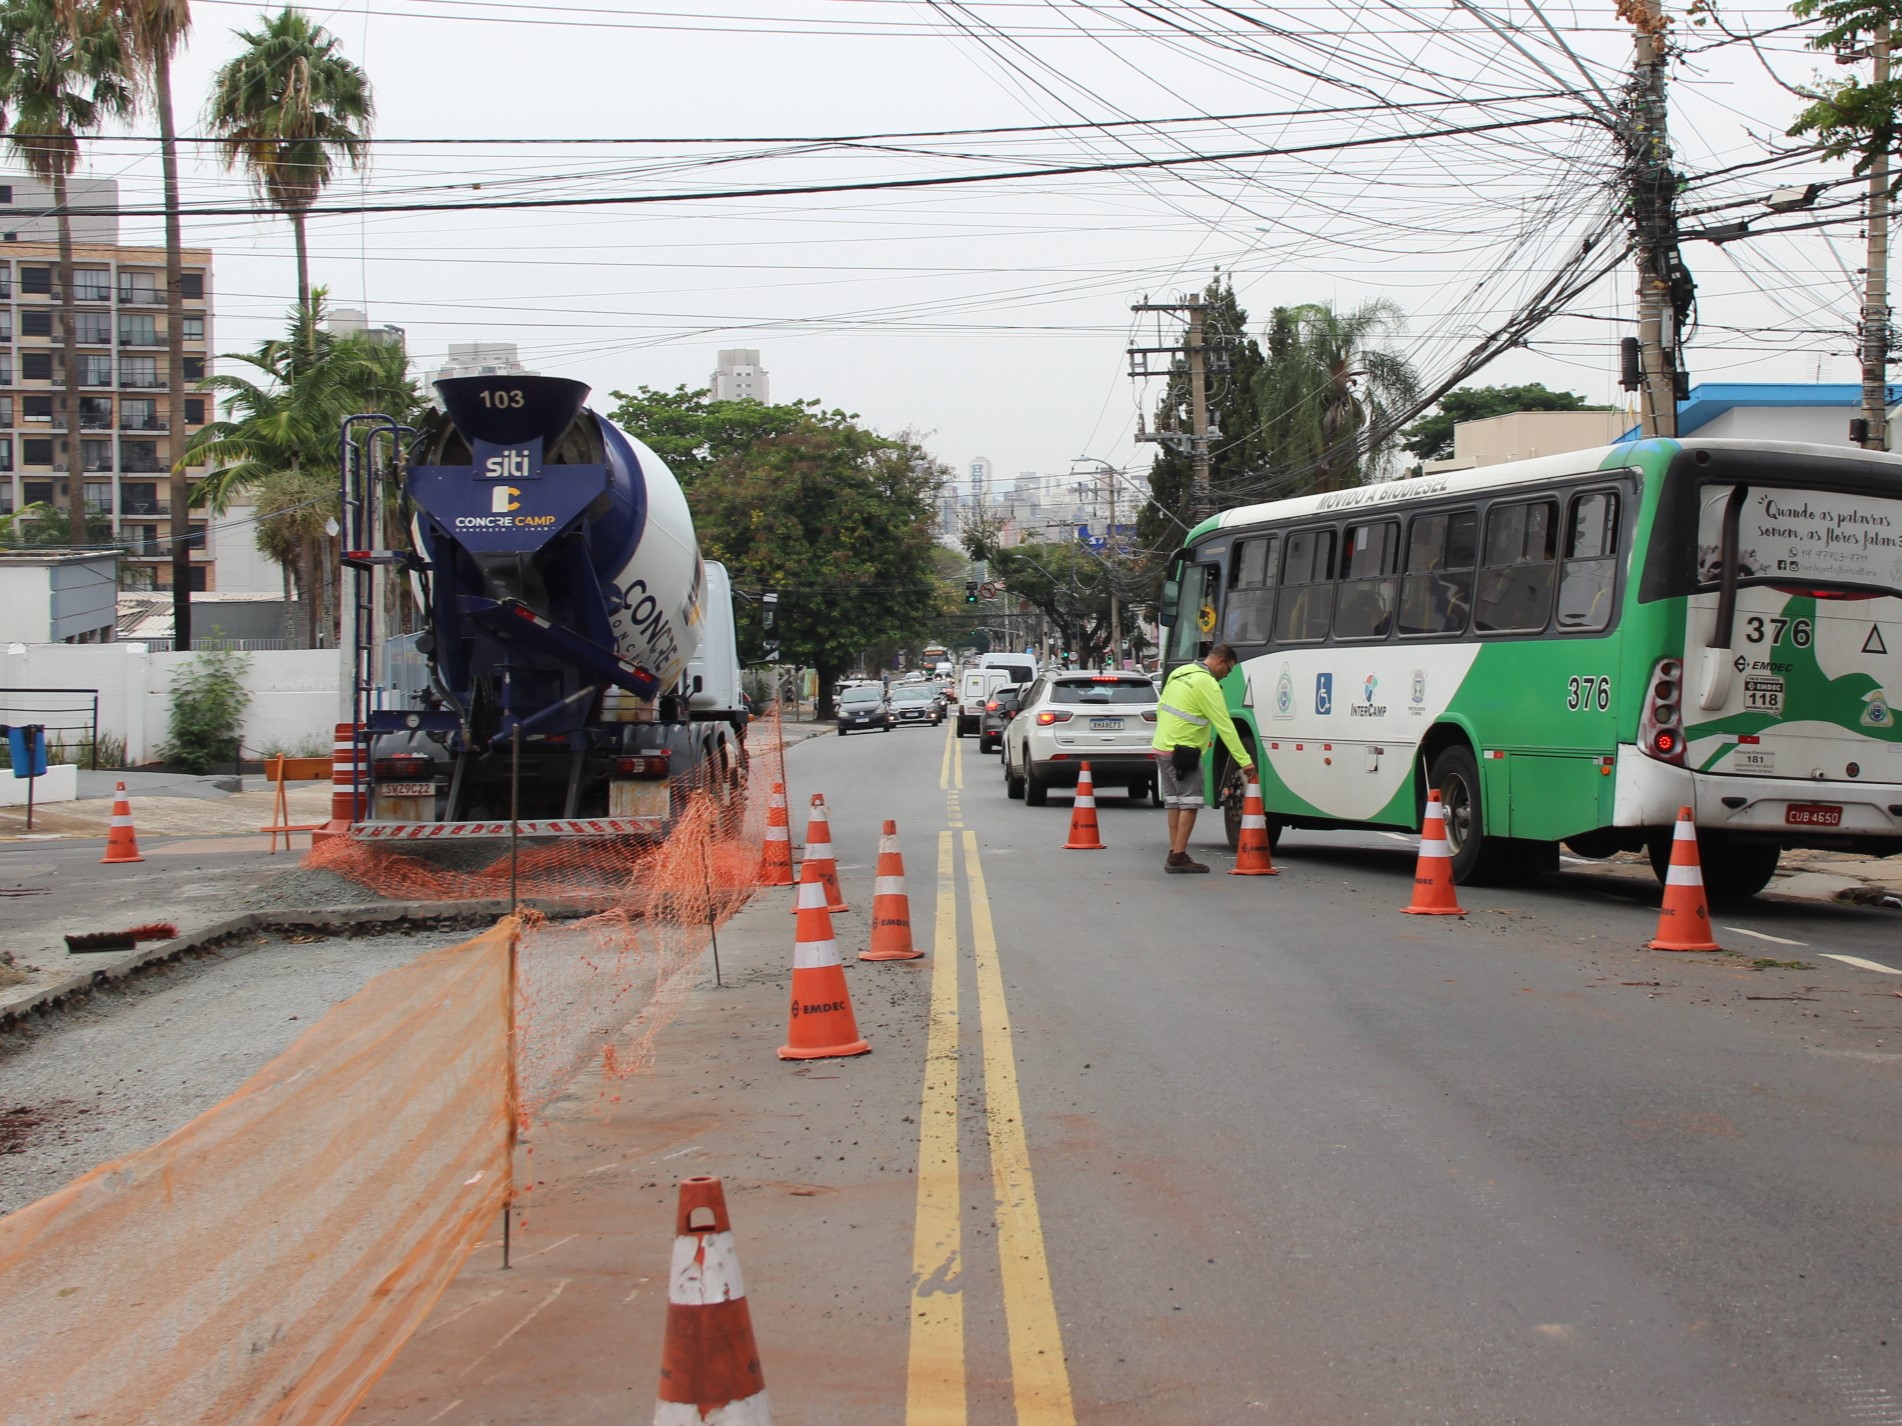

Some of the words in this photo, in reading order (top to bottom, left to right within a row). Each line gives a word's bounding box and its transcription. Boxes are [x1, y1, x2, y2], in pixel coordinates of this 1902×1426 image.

[480, 390, 525, 409] 103
[485, 450, 530, 477] siti
[1316, 489, 1364, 511] MOVIDO
[1365, 491, 1376, 503] A
[1379, 477, 1450, 501] BIODIESEL
[455, 517, 513, 527] CONCRE
[515, 516, 556, 526] CAMP
[1765, 499, 1816, 520] Quando
[1820, 511, 1834, 522] as
[1837, 510, 1891, 528] palavras
[1758, 525, 1803, 541] somem,
[1807, 530, 1821, 541] as
[1825, 526, 1859, 548] flores
[1862, 530, 1896, 551] falam
[1745, 616, 1813, 649] 376
[1752, 661, 1793, 673] EMDEC
[1567, 675, 1611, 712] 376
[1749, 692, 1778, 706] 118
[1746, 755, 1764, 764] 181
[803, 1001, 846, 1014] EMDEC
